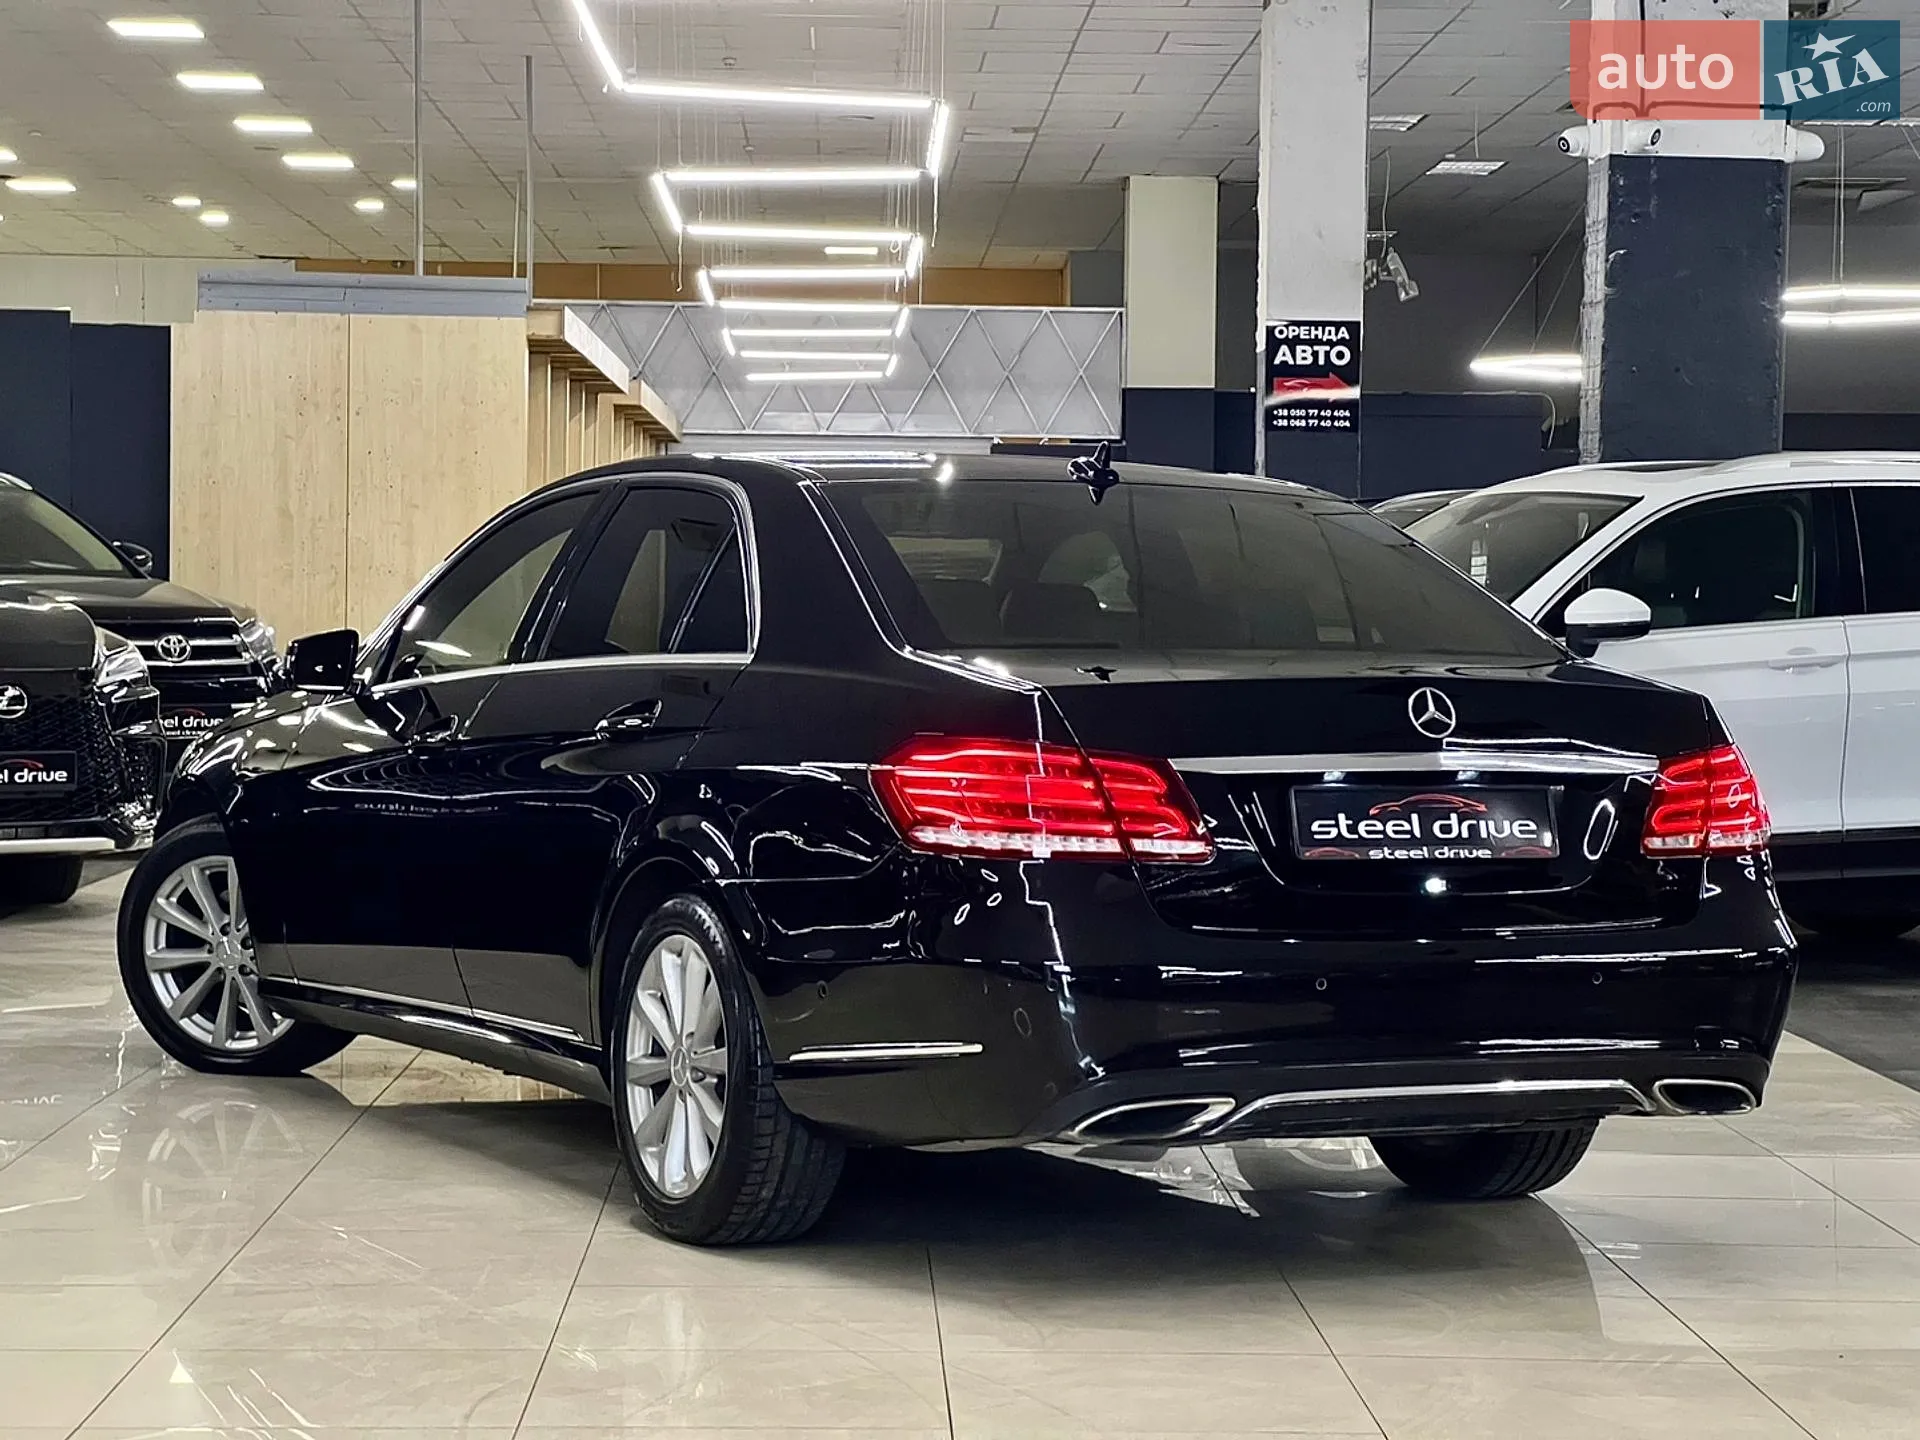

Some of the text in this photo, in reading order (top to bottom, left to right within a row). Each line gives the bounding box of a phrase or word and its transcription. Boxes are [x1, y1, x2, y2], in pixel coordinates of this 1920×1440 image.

[1274, 326, 1350, 342] ОРЕНДА
[1273, 344, 1351, 366] АВТО
[1333, 409, 1351, 417] 404
[1333, 419, 1351, 427] 404
[14, 768, 68, 783] drive
[1310, 813, 1538, 839] steel drive
[1368, 847, 1492, 859] steel drive
